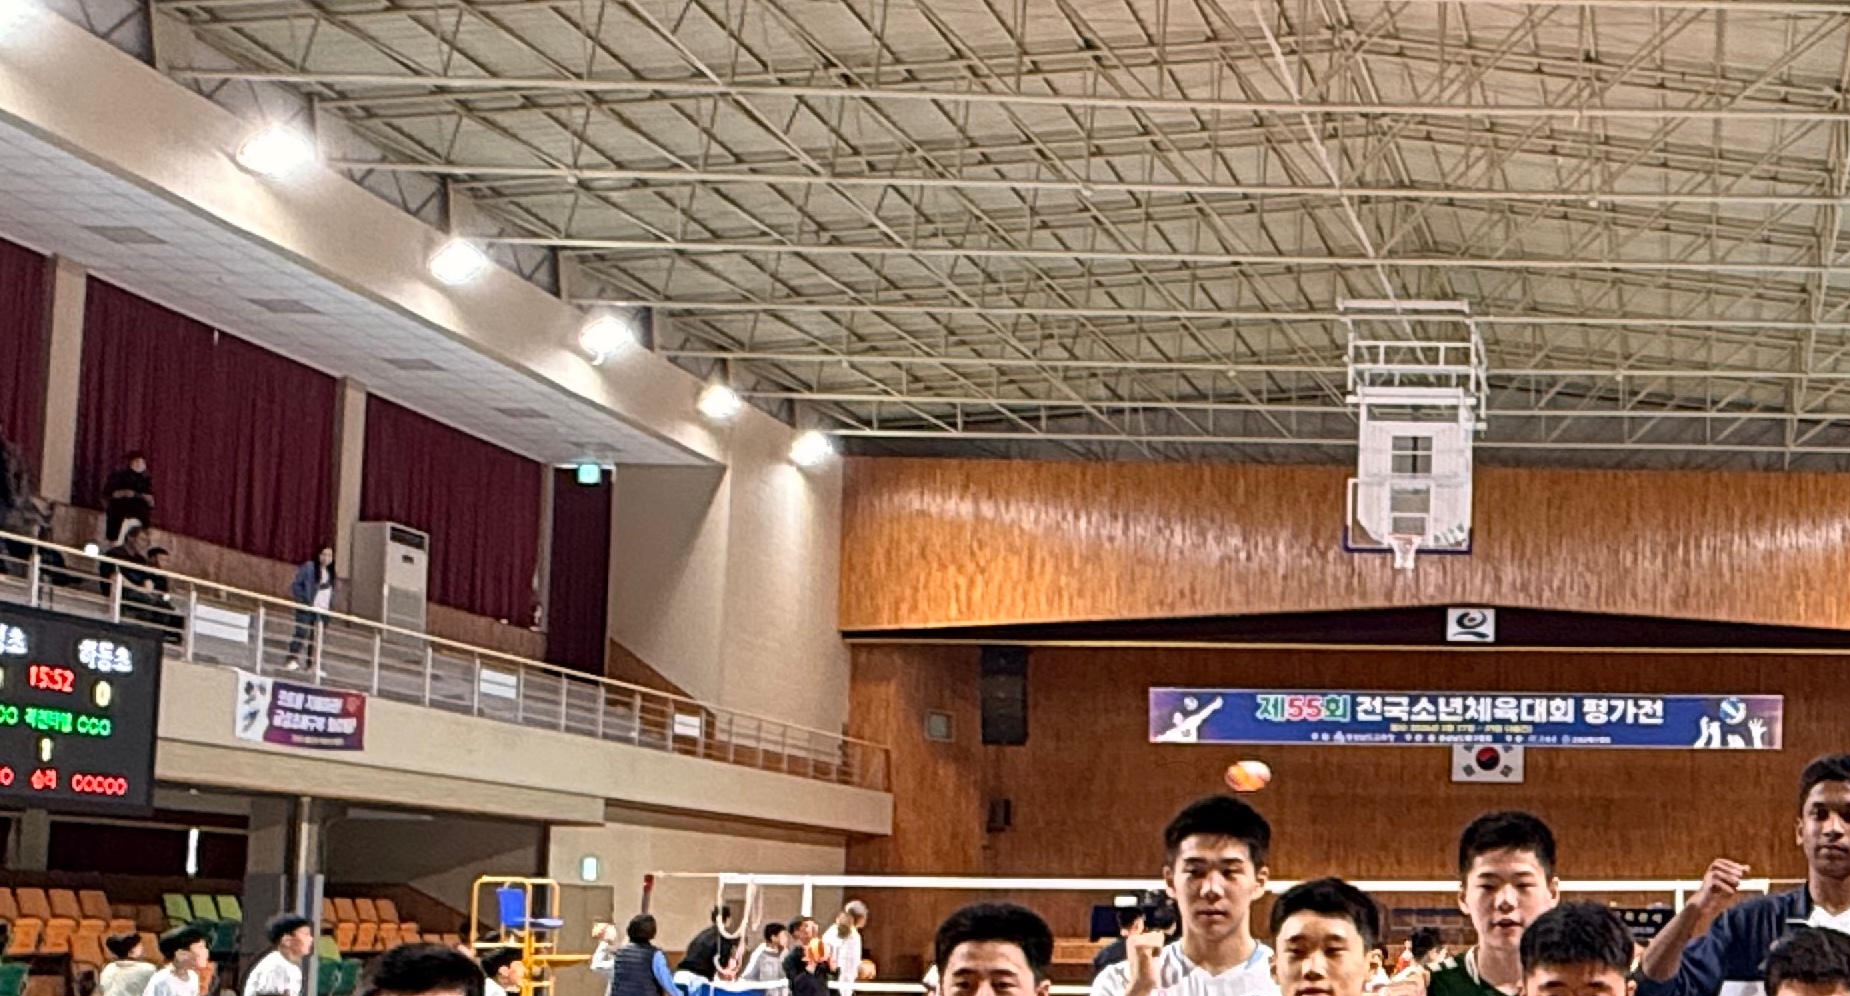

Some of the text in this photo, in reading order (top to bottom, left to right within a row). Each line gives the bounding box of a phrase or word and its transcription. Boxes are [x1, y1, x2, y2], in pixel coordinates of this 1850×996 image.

[1256, 694, 1665, 724] 제55회 전국소년체육대회 평가전
